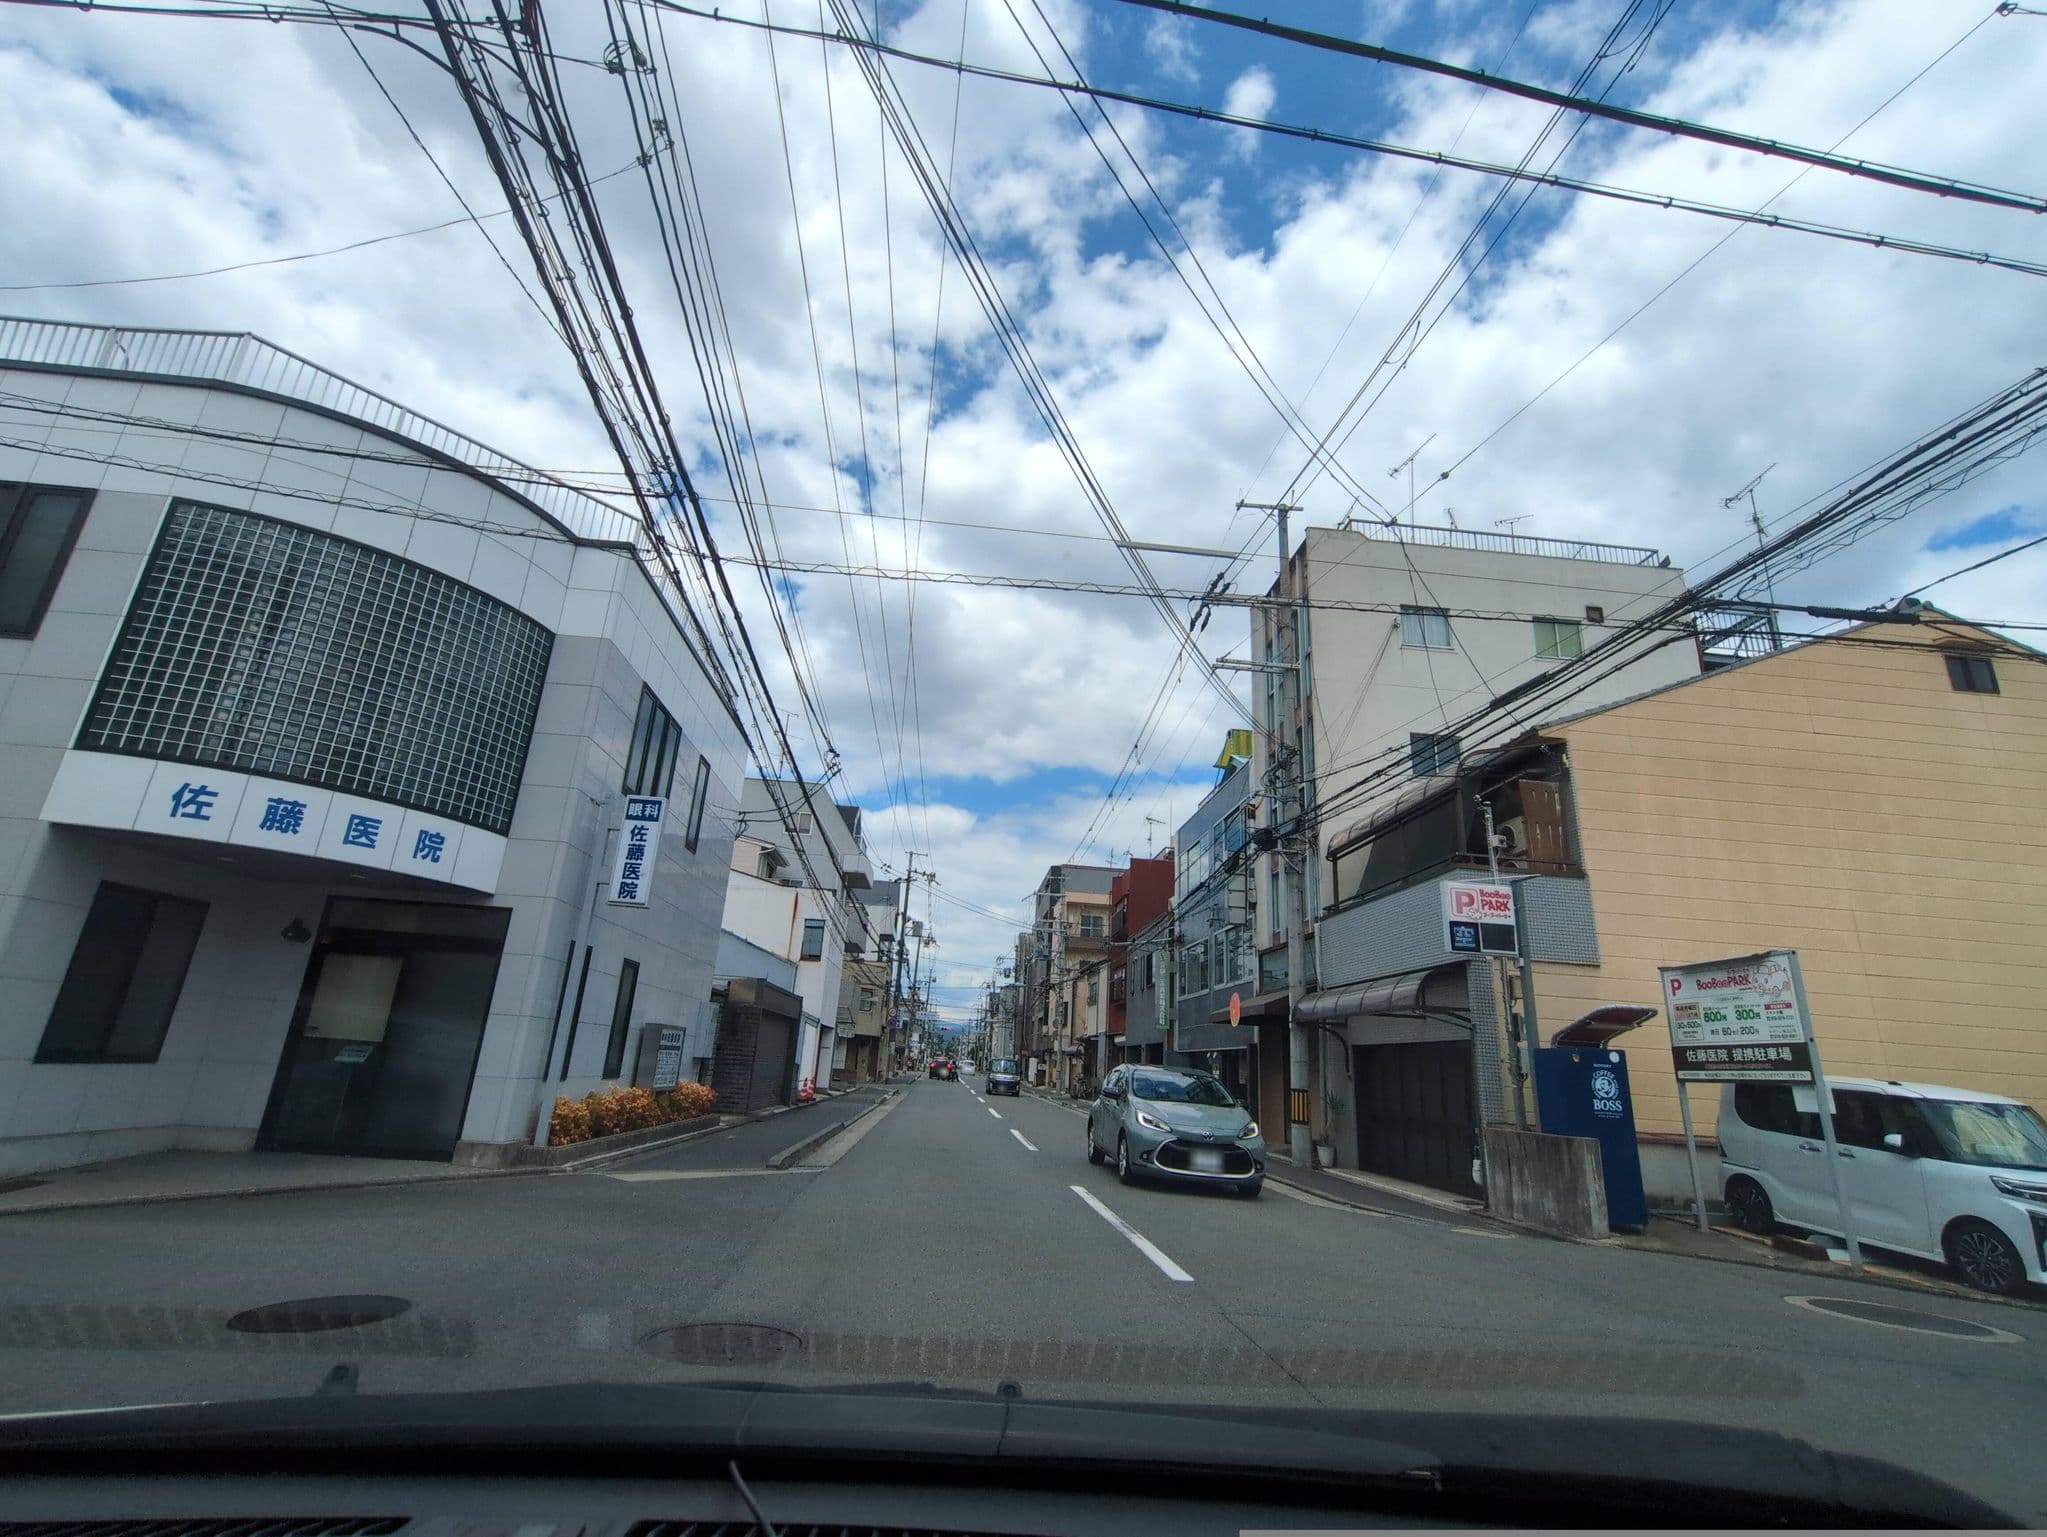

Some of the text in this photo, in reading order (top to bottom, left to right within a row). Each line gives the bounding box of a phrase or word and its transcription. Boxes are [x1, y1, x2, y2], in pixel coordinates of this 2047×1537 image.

[628, 803, 659, 818] 眼科
[169, 782, 446, 863] 佐藤医院
[617, 824, 649, 900] 佐藤医院
[1455, 891, 1475, 914] P
[1481, 899, 1511, 912] PARK
[1671, 979, 1682, 997] P
[1735, 1008, 1761, 1021] 300円
[1686, 1046, 1793, 1062] 佐藤医院 提携駐車場
[1593, 1070, 1615, 1079] COFFEE
[1593, 1099, 1623, 1112] BOSS
